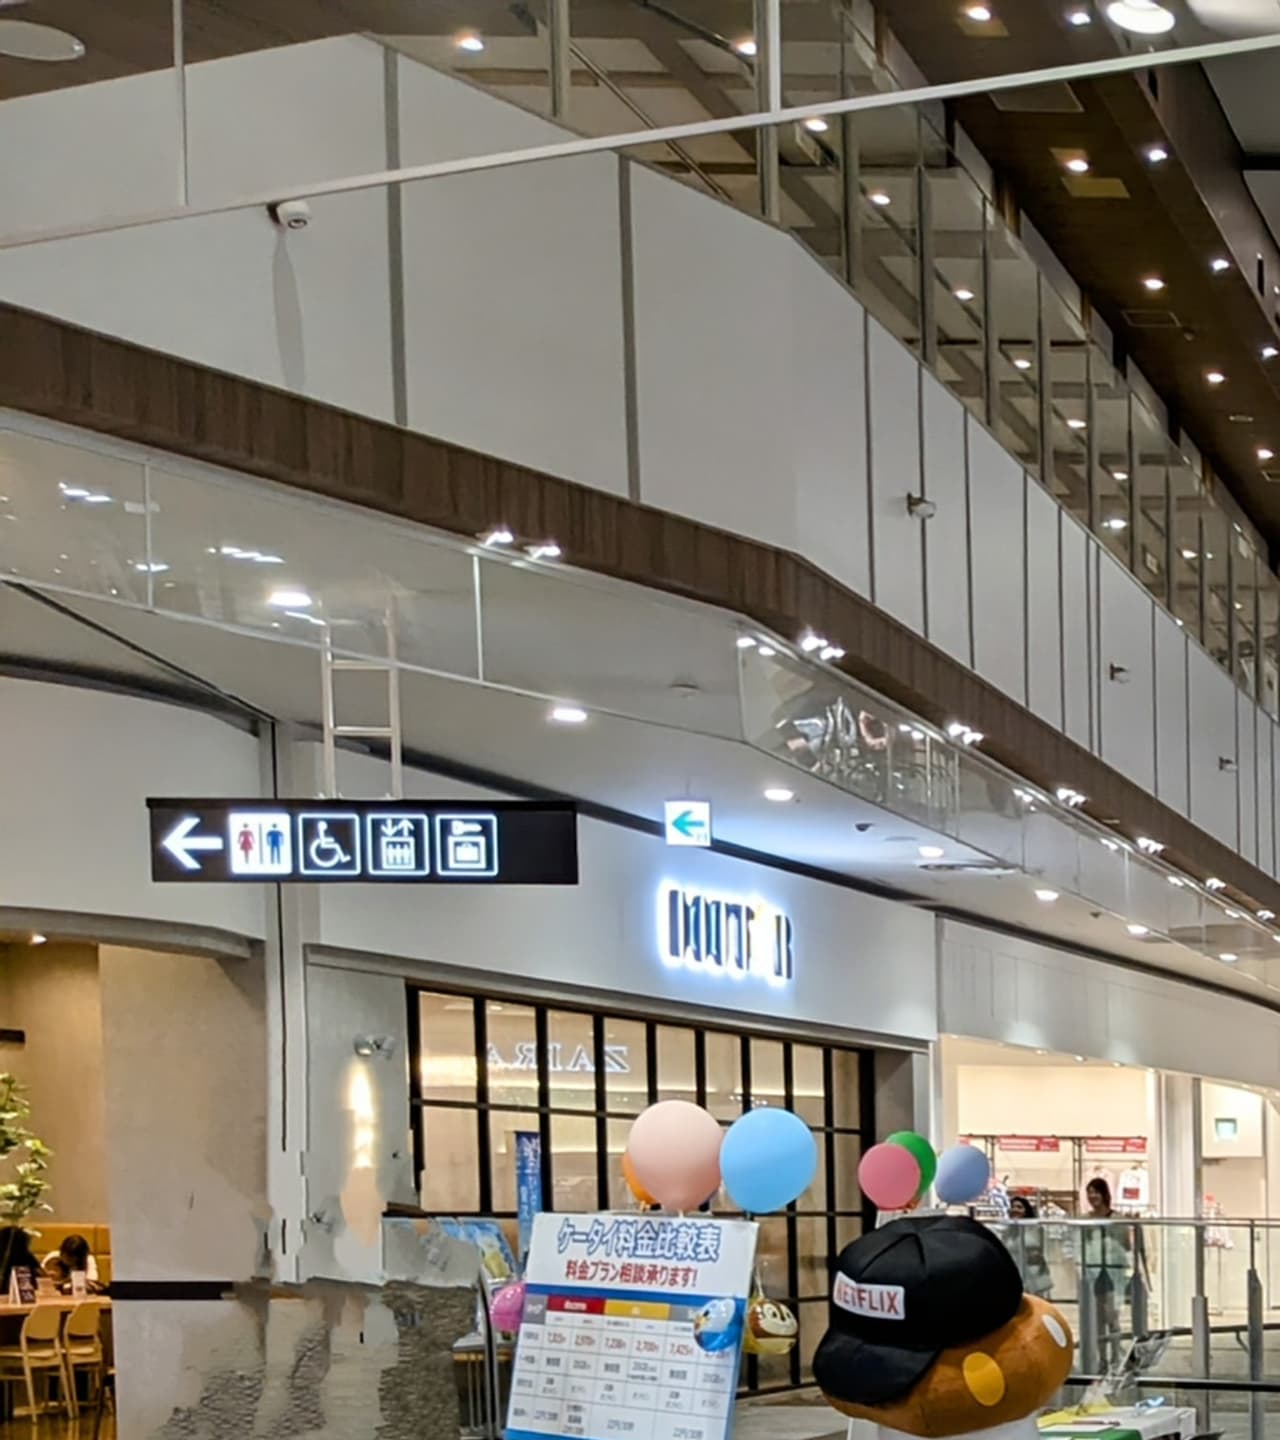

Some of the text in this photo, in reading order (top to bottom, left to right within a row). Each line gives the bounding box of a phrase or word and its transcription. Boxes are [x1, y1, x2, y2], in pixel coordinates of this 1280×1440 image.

[558, 1217, 722, 1262] ケータイ料金比較表
